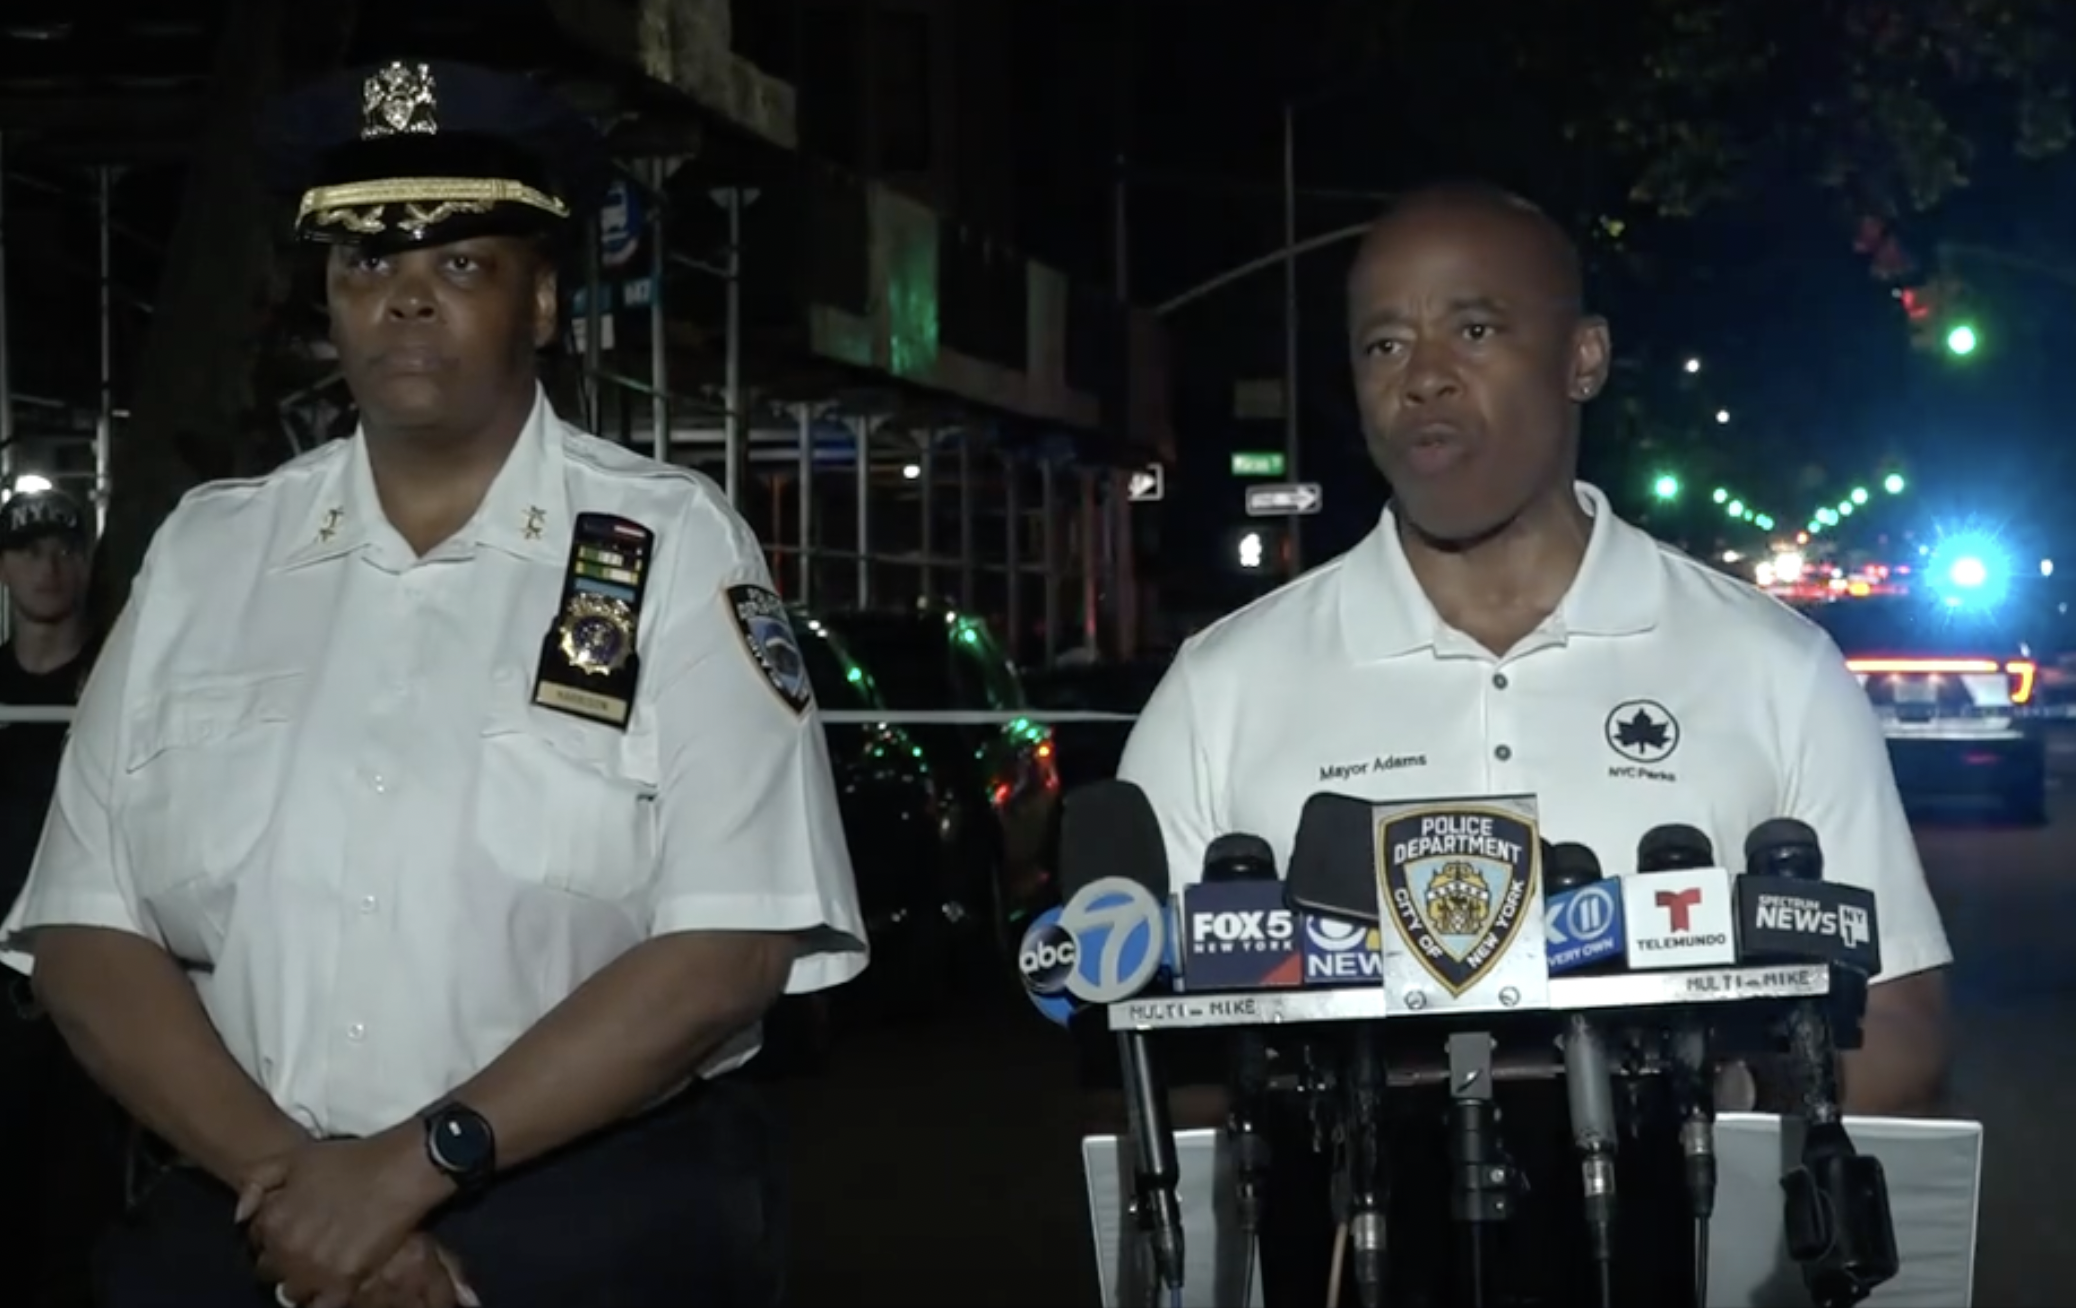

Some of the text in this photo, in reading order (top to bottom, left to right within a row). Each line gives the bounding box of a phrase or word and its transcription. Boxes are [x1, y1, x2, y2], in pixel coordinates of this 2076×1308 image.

[1319, 754, 1427, 781] Mayor Adams
[1609, 766, 1676, 782] NYC Parks
[1421, 815, 1494, 836] POLICE
[1393, 834, 1522, 865] DEPARTMENT
[1758, 894, 1821, 911] SPECTRUM
[1394, 888, 1444, 959] CITY OF
[1466, 879, 1525, 968] NEW YORK
[1756, 906, 1838, 936] NEWS
[1193, 939, 1294, 953] NEW YORK
[1582, 938, 1614, 957] OWN
[1636, 934, 1727, 951] TELEMUNDO
[1019, 941, 1075, 973] abc
[1308, 951, 1383, 977] NEW
